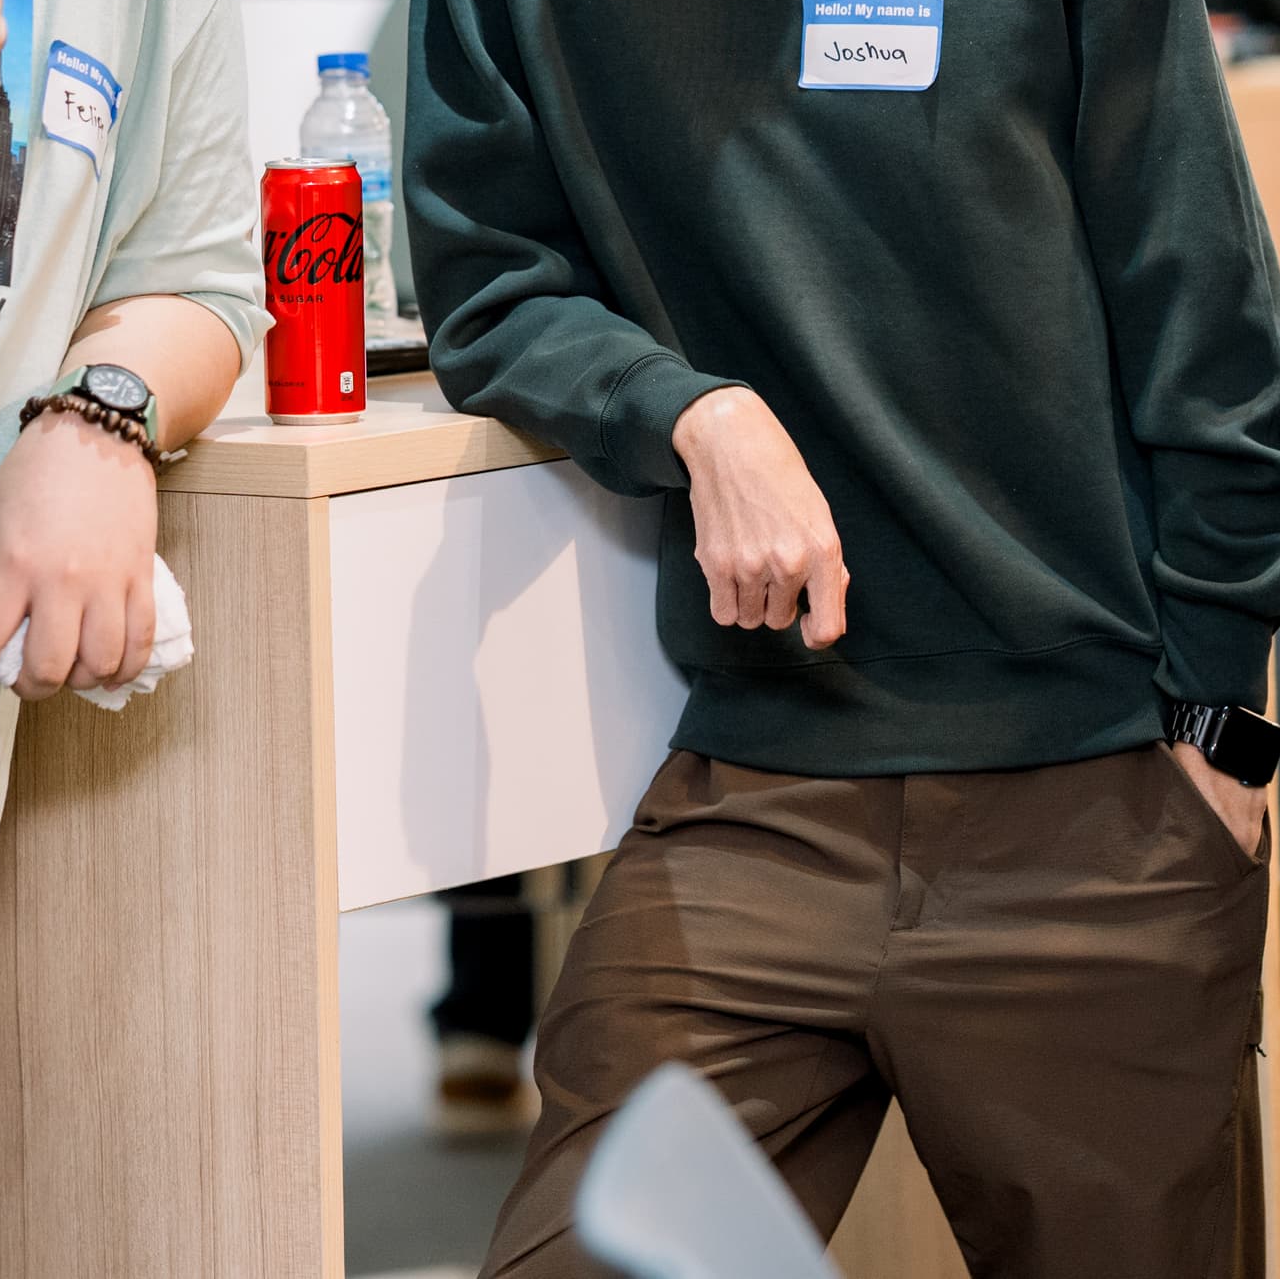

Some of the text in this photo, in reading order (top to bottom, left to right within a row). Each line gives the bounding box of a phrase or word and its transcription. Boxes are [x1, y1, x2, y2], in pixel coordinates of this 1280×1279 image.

[815, 3, 931, 19] Hello! My name is
[56, 50, 89, 75] Hello!
[824, 41, 908, 65] Joshua
[279, 294, 324, 303] SUGAR
